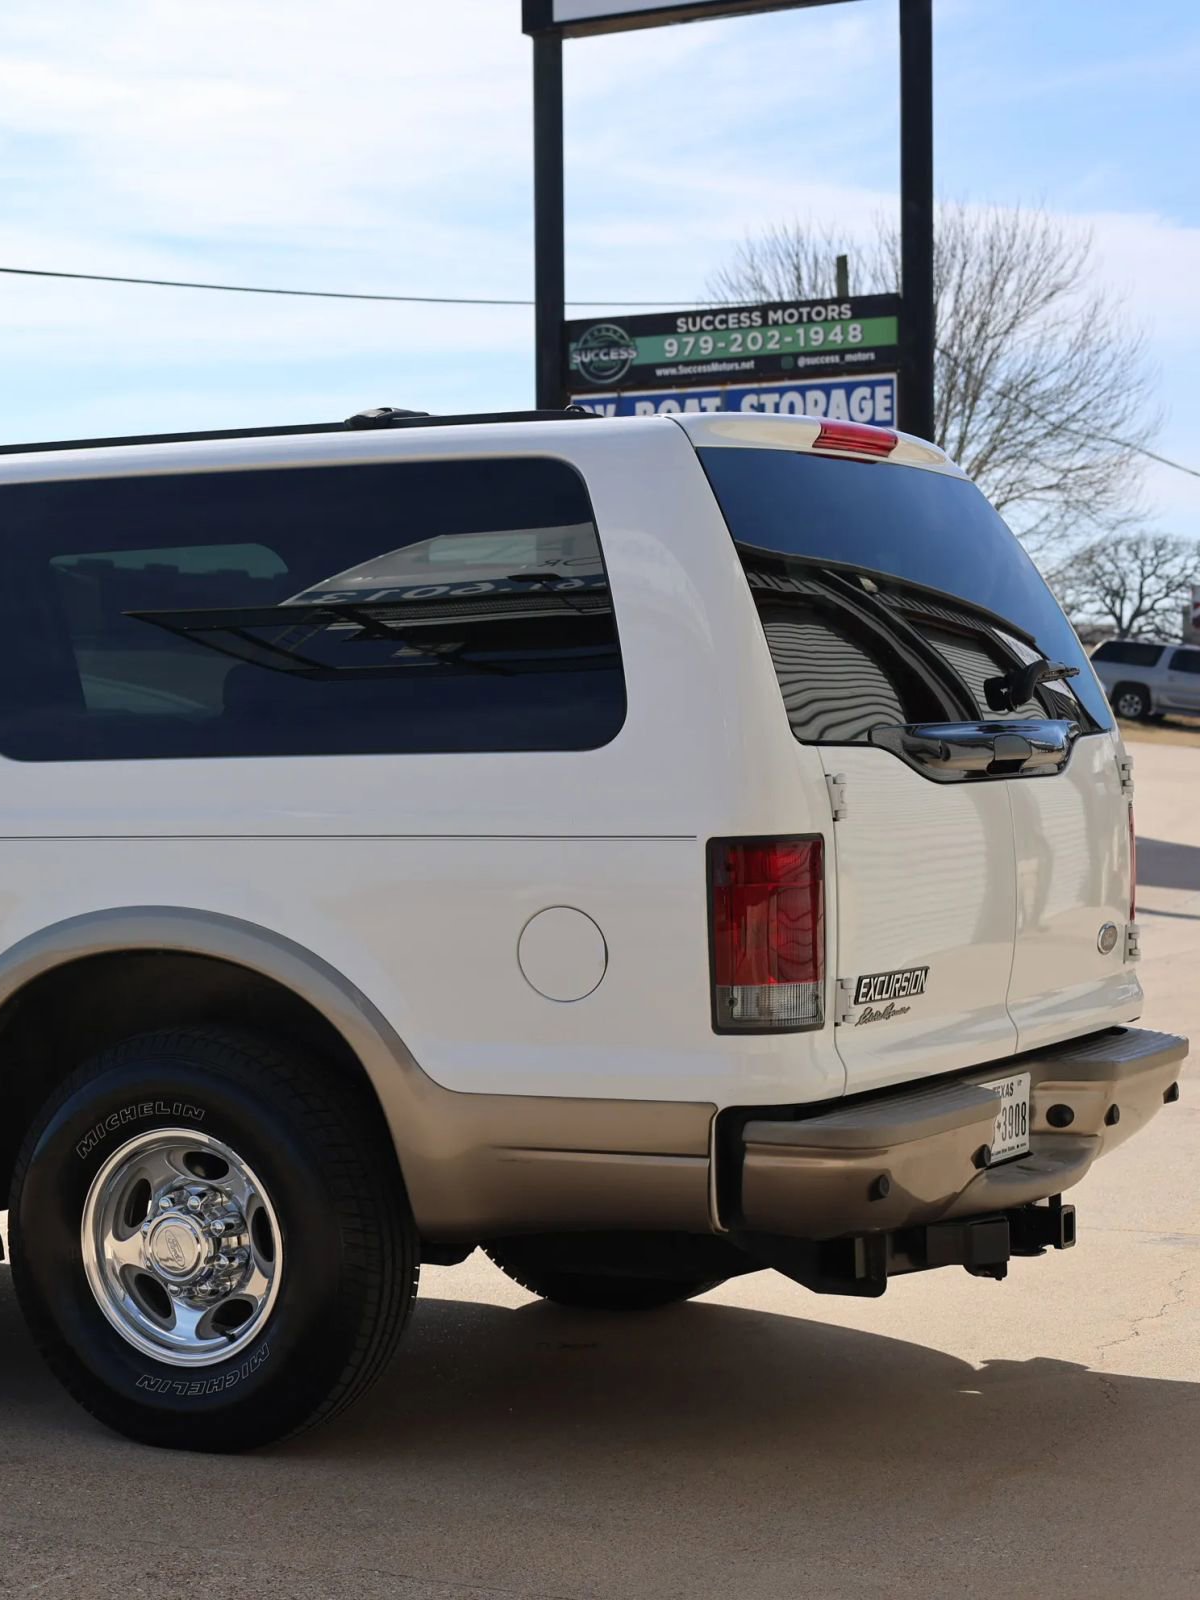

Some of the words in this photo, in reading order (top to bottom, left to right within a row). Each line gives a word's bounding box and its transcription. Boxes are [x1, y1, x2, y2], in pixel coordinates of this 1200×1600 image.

[676, 311, 762, 333] SUCCESS
[768, 303, 852, 325] MOTORS
[572, 346, 638, 363] SUCCESS
[663, 323, 863, 358] 979-202-1948
[740, 385, 892, 423] STORAGE
[858, 969, 929, 1003] EXCURSION
[75, 1101, 206, 1160] MICHELIN
[1001, 1101, 1027, 1142] 3908
[135, 1341, 270, 1396] MICHELIN
